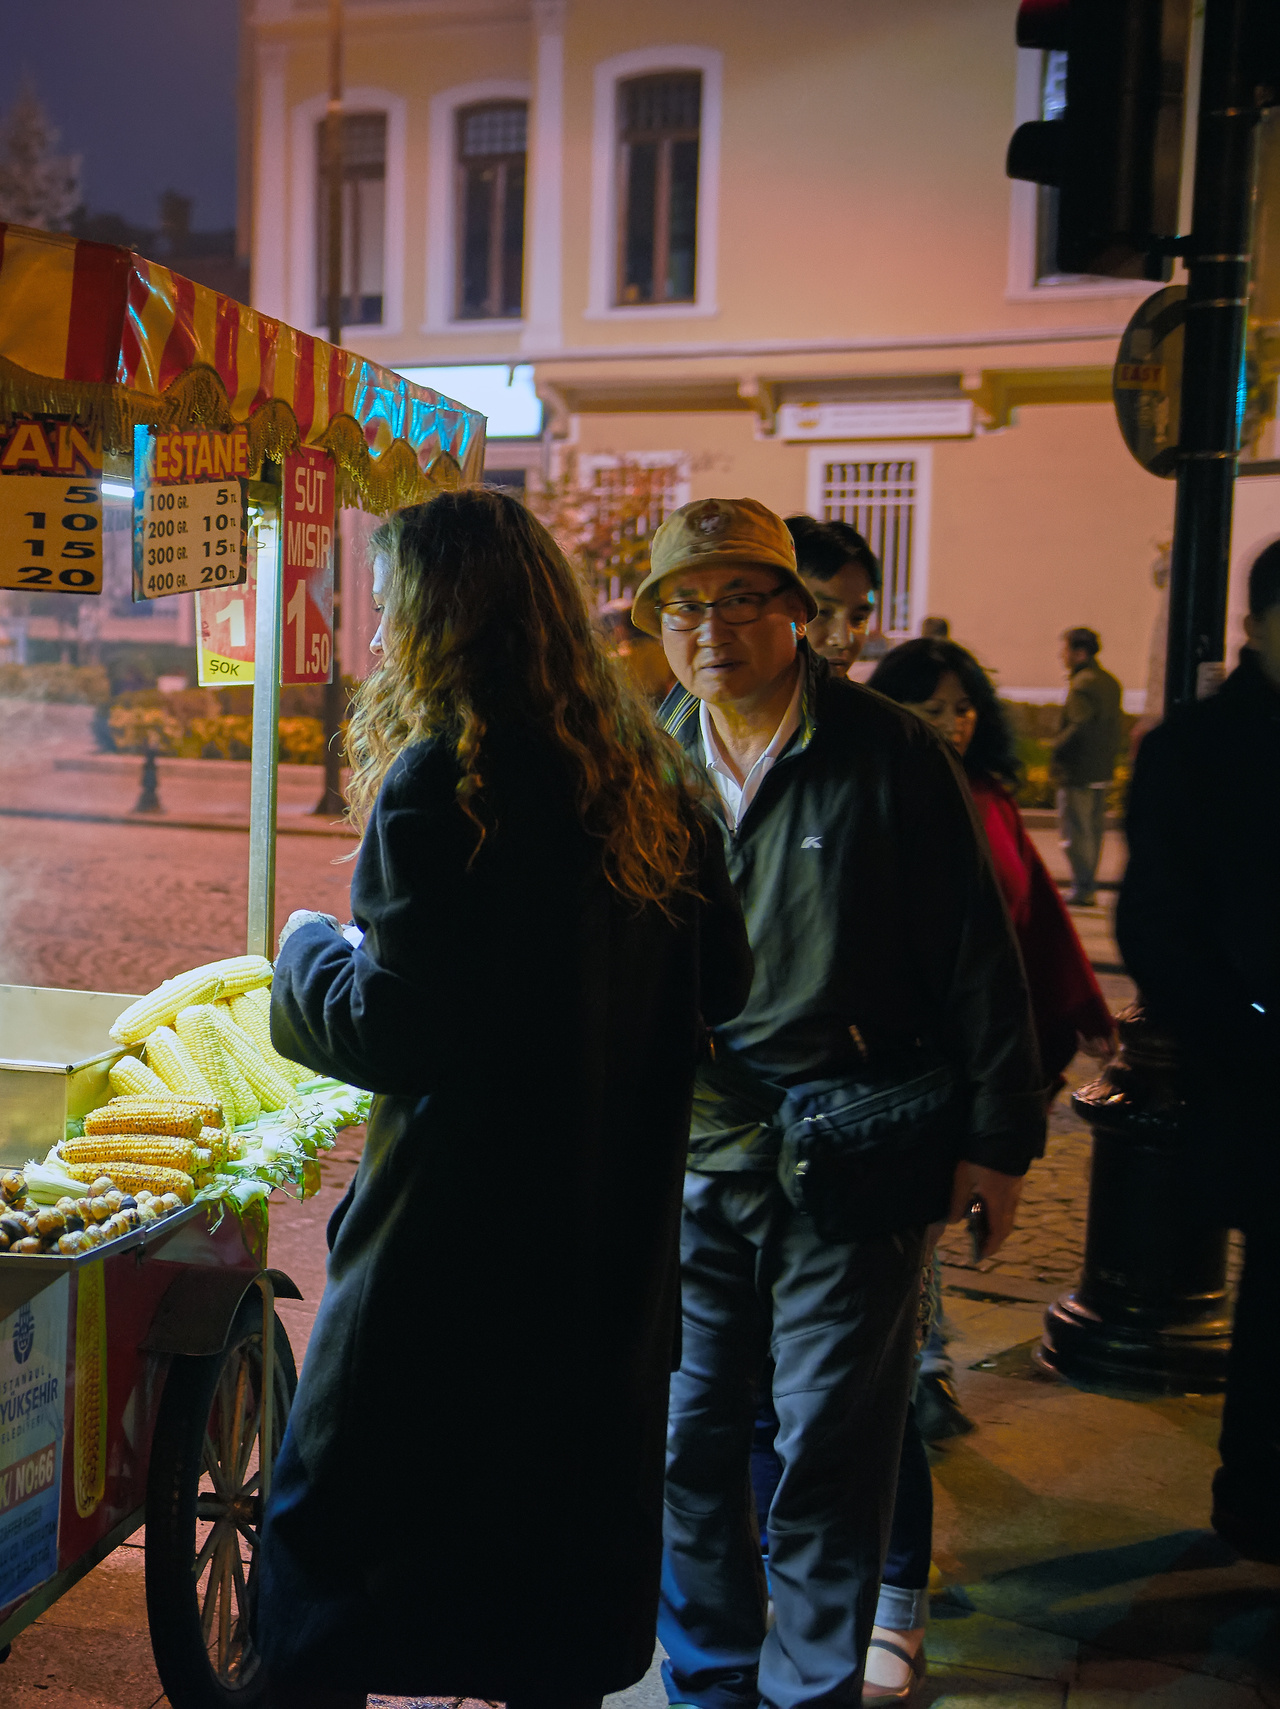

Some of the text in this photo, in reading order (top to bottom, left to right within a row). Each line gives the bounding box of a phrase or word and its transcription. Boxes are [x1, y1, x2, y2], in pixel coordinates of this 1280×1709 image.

[64, 485, 99, 504] 5
[294, 457, 326, 514] SÜT
[149, 493, 174, 512] 100
[177, 495, 189, 509] GR.
[216, 488, 228, 505] 5
[24, 511, 98, 531] 10
[148, 520, 174, 538] 200
[177, 521, 188, 534] GR.
[202, 514, 228, 532] 10
[23, 539, 96, 559] 15
[148, 547, 174, 566] 300
[177, 548, 188, 560] GR.
[202, 540, 228, 558] 15
[287, 521, 331, 569] MISIR
[18, 566, 95, 586] 20
[147, 573, 174, 591] 400
[176, 574, 188, 588] GR.
[200, 564, 227, 584] 20
[209, 659, 240, 676] ŞOK
[15, 1449, 54, 1501] NO:66
